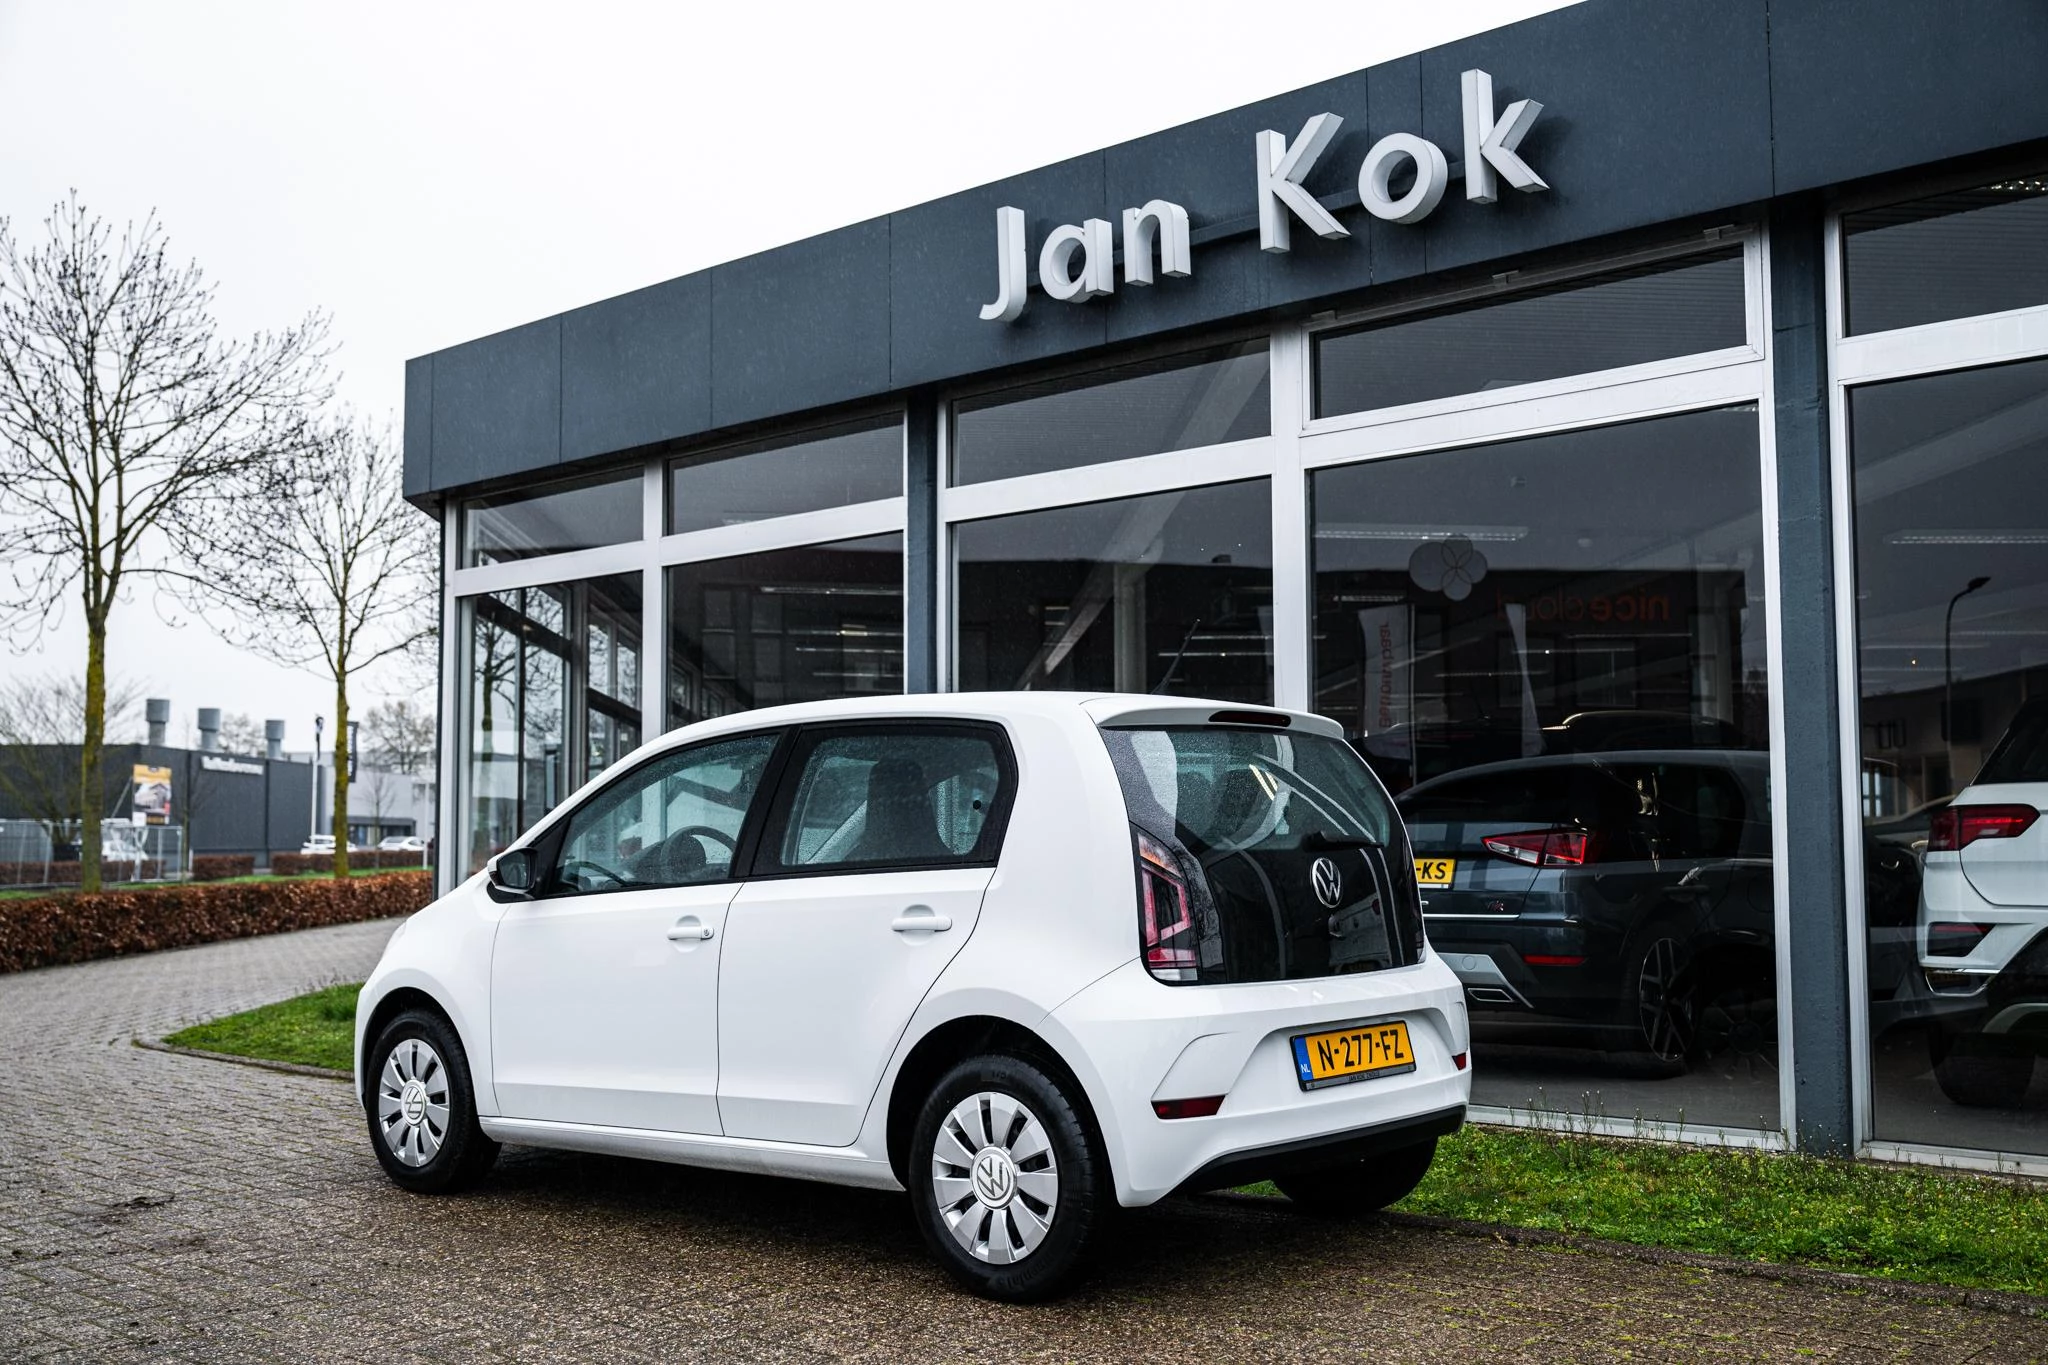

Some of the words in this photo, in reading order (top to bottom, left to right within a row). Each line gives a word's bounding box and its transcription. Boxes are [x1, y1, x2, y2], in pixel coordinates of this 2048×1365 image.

[979, 200, 1191, 322] Jan
[1256, 69, 1550, 253] Kok
[1301, 1063, 1311, 1074] NL
[1316, 1029, 1405, 1072] N-277-FZ
